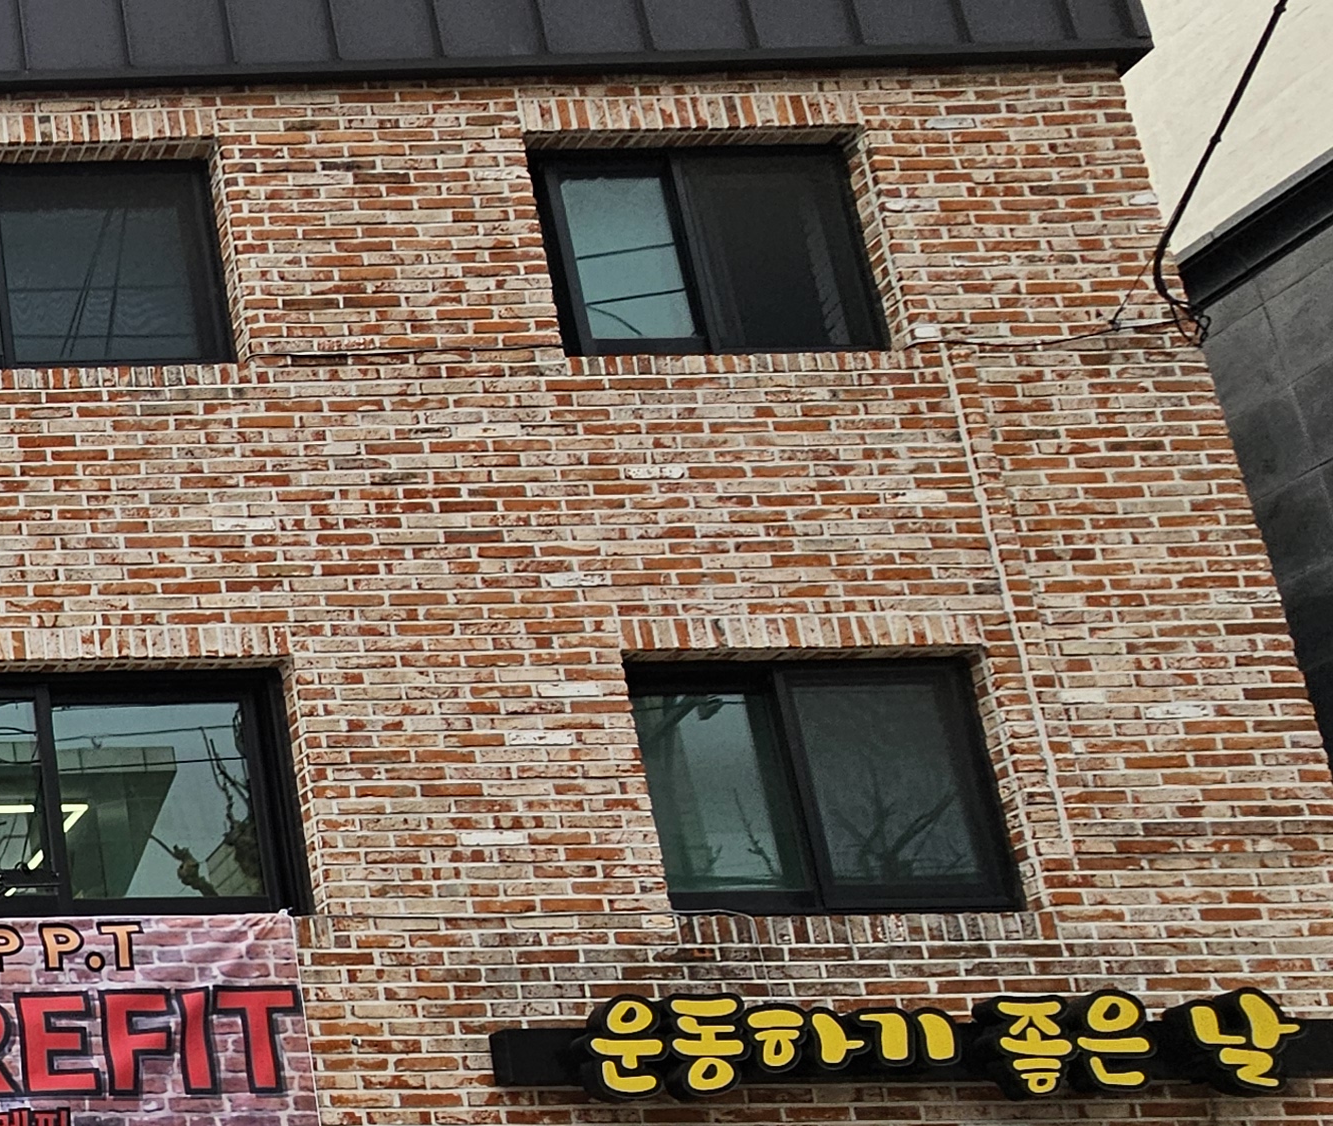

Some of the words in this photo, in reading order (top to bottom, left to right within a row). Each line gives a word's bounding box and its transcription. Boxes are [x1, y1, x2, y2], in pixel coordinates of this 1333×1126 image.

[38, 921, 143, 972] P.T
[590, 995, 959, 1096] 운동하기
[998, 993, 1151, 1096] 좋은
[1188, 992, 1301, 1090] 날
